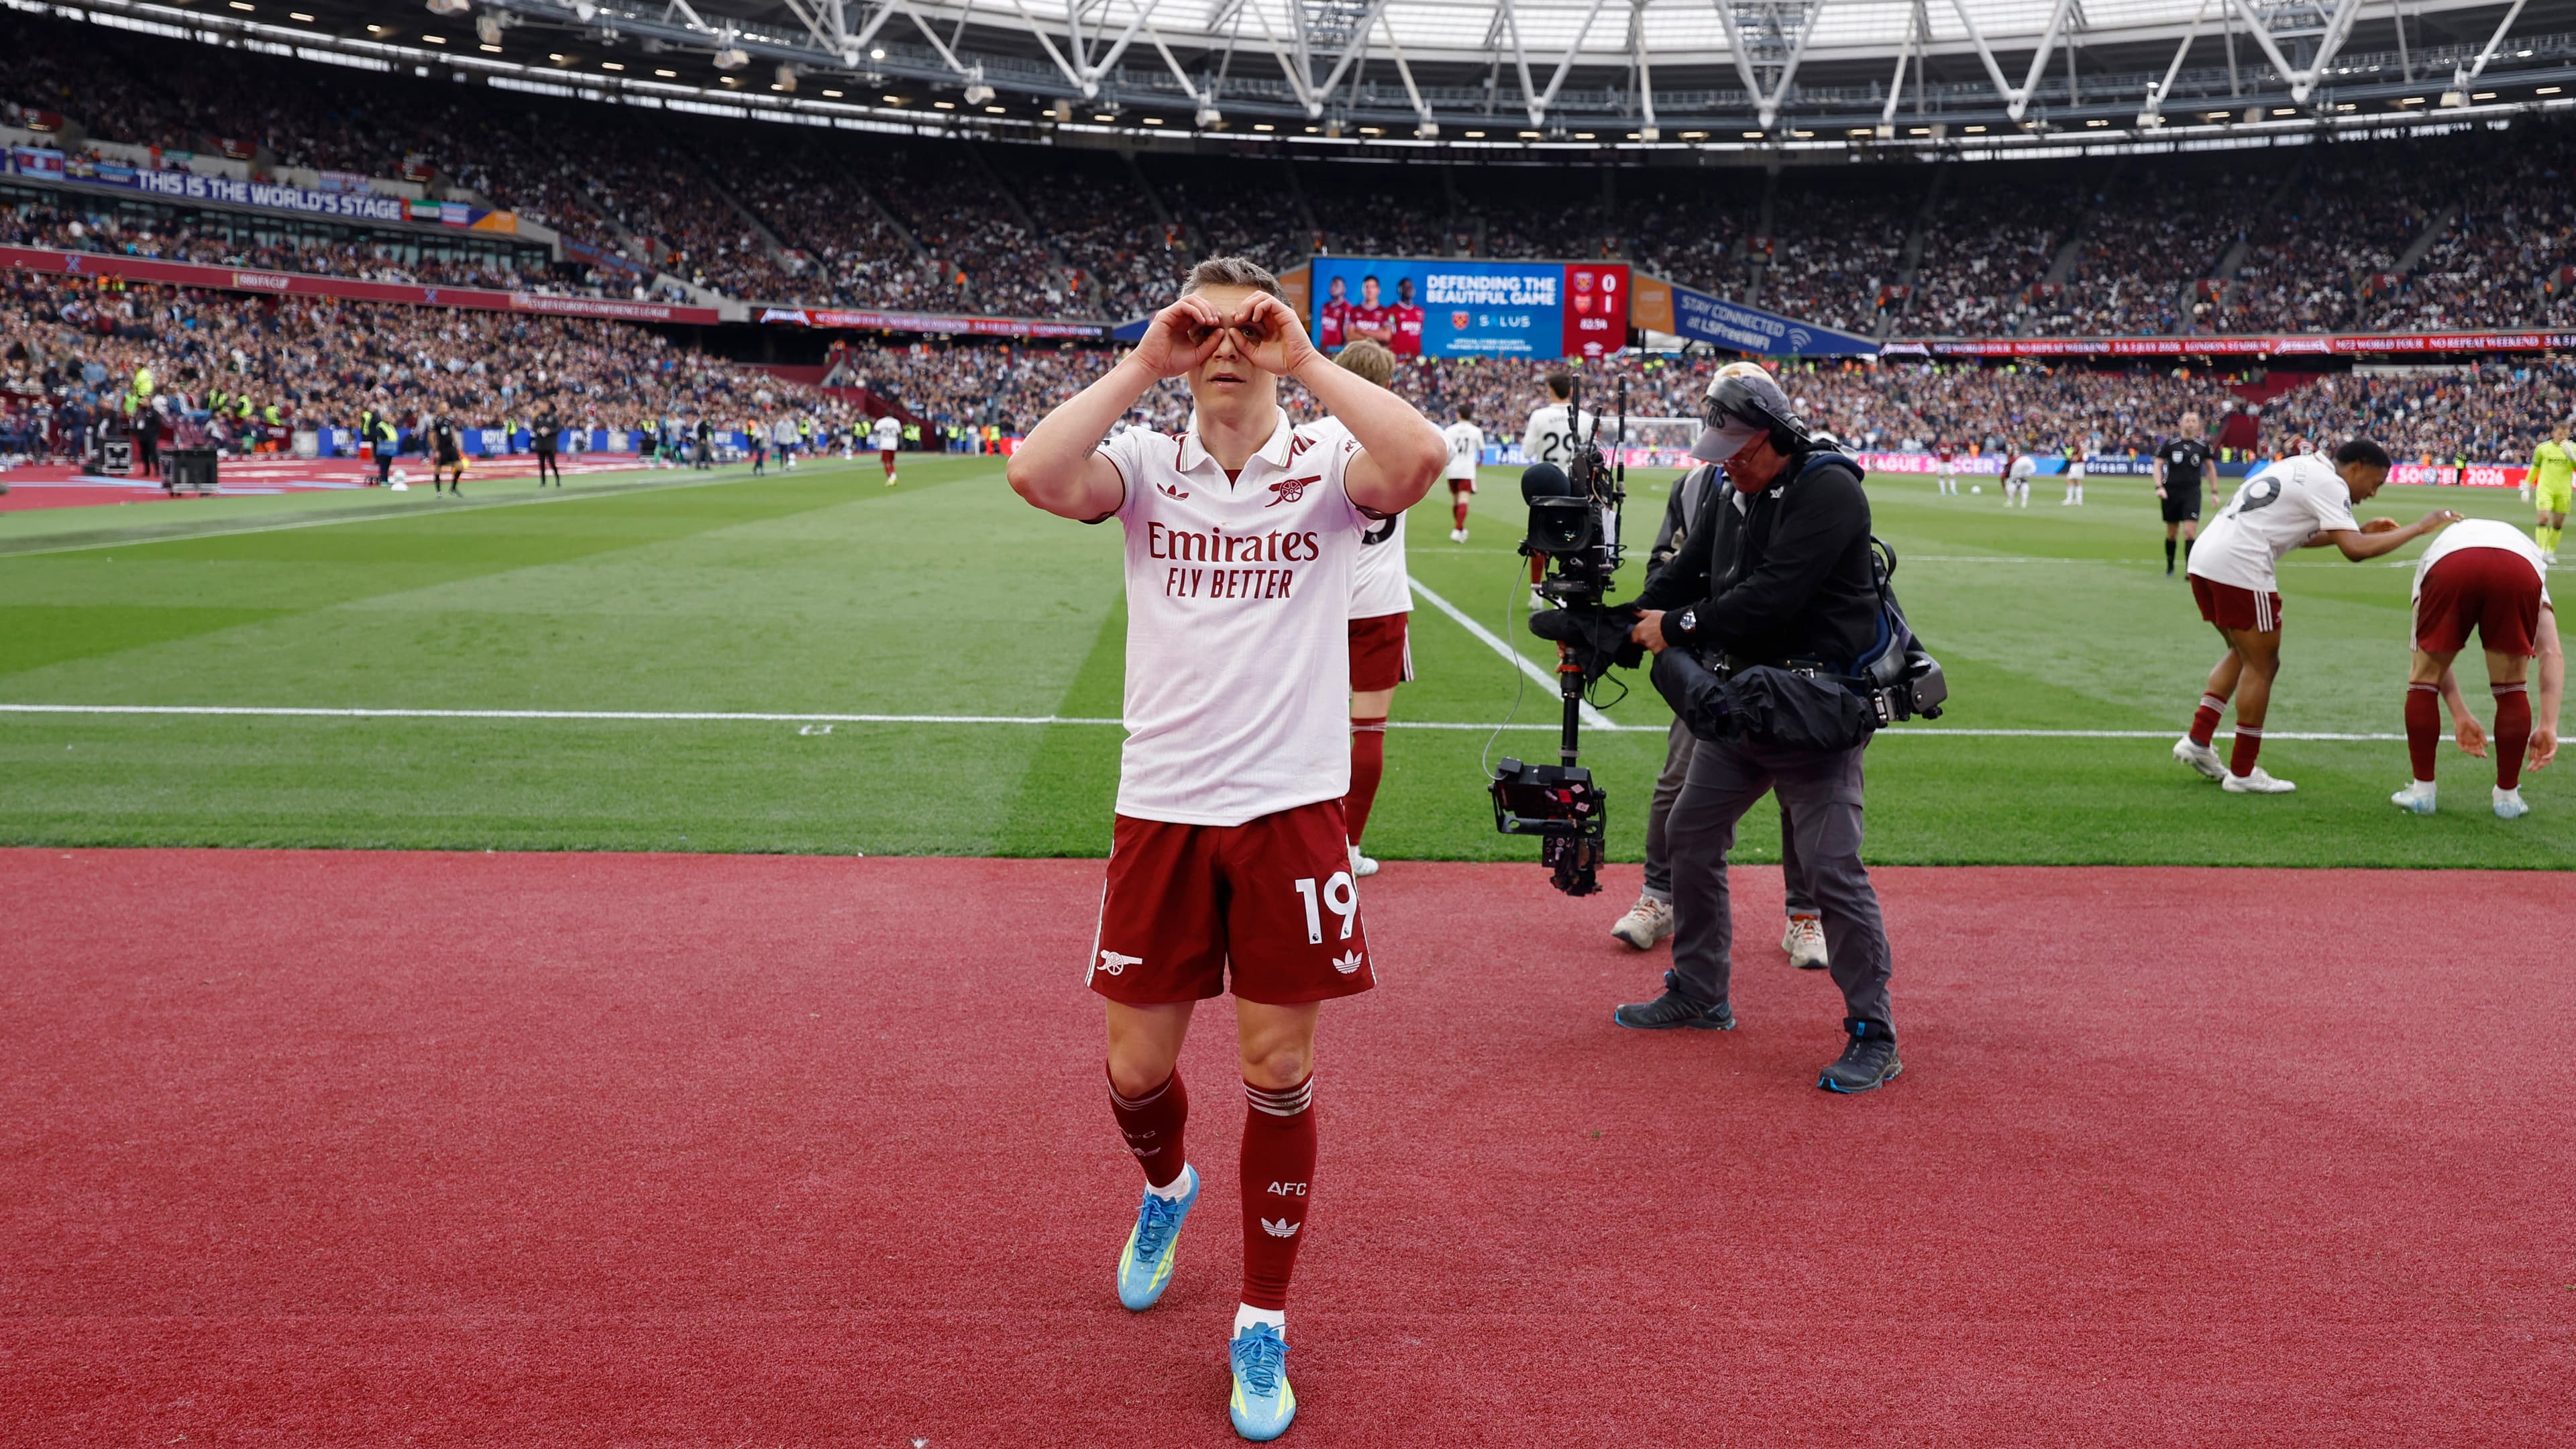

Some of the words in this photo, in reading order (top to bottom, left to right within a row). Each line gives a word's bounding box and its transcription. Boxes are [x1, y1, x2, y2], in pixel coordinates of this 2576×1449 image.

[136, 169, 183, 194] THIS
[186, 176, 206, 197] IS
[207, 179, 248, 203] THE
[250, 184, 337, 213] WORLD'S
[340, 195, 401, 220] STAGE
[1427, 274, 1521, 290] DEFENDING
[1523, 277, 1556, 292] THE
[1602, 273, 1617, 292] 0
[1426, 289, 1509, 305] BEAUTIFUL
[1511, 291, 1556, 305] GAME
[1681, 295, 1711, 315] STAY
[1712, 304, 1786, 338] CONNECTED
[2357, 339, 2394, 350] WORLD
[2396, 338, 2424, 349] TOUR
[2429, 337, 2447, 348] NO
[2486, 335, 2539, 347] WEEKEND
[1865, 456, 1921, 473] LAGUE
[1926, 457, 1996, 474] SCCER
[2086, 462, 2128, 473] dream
[2467, 470, 2506, 486] 2026
[1147, 521, 1319, 562] Emirates
[1167, 568, 1203, 598] FLY
[1210, 570, 1293, 600] BETTER
[1295, 871, 1358, 945] 19
[1267, 1181, 1307, 1196] AFC
